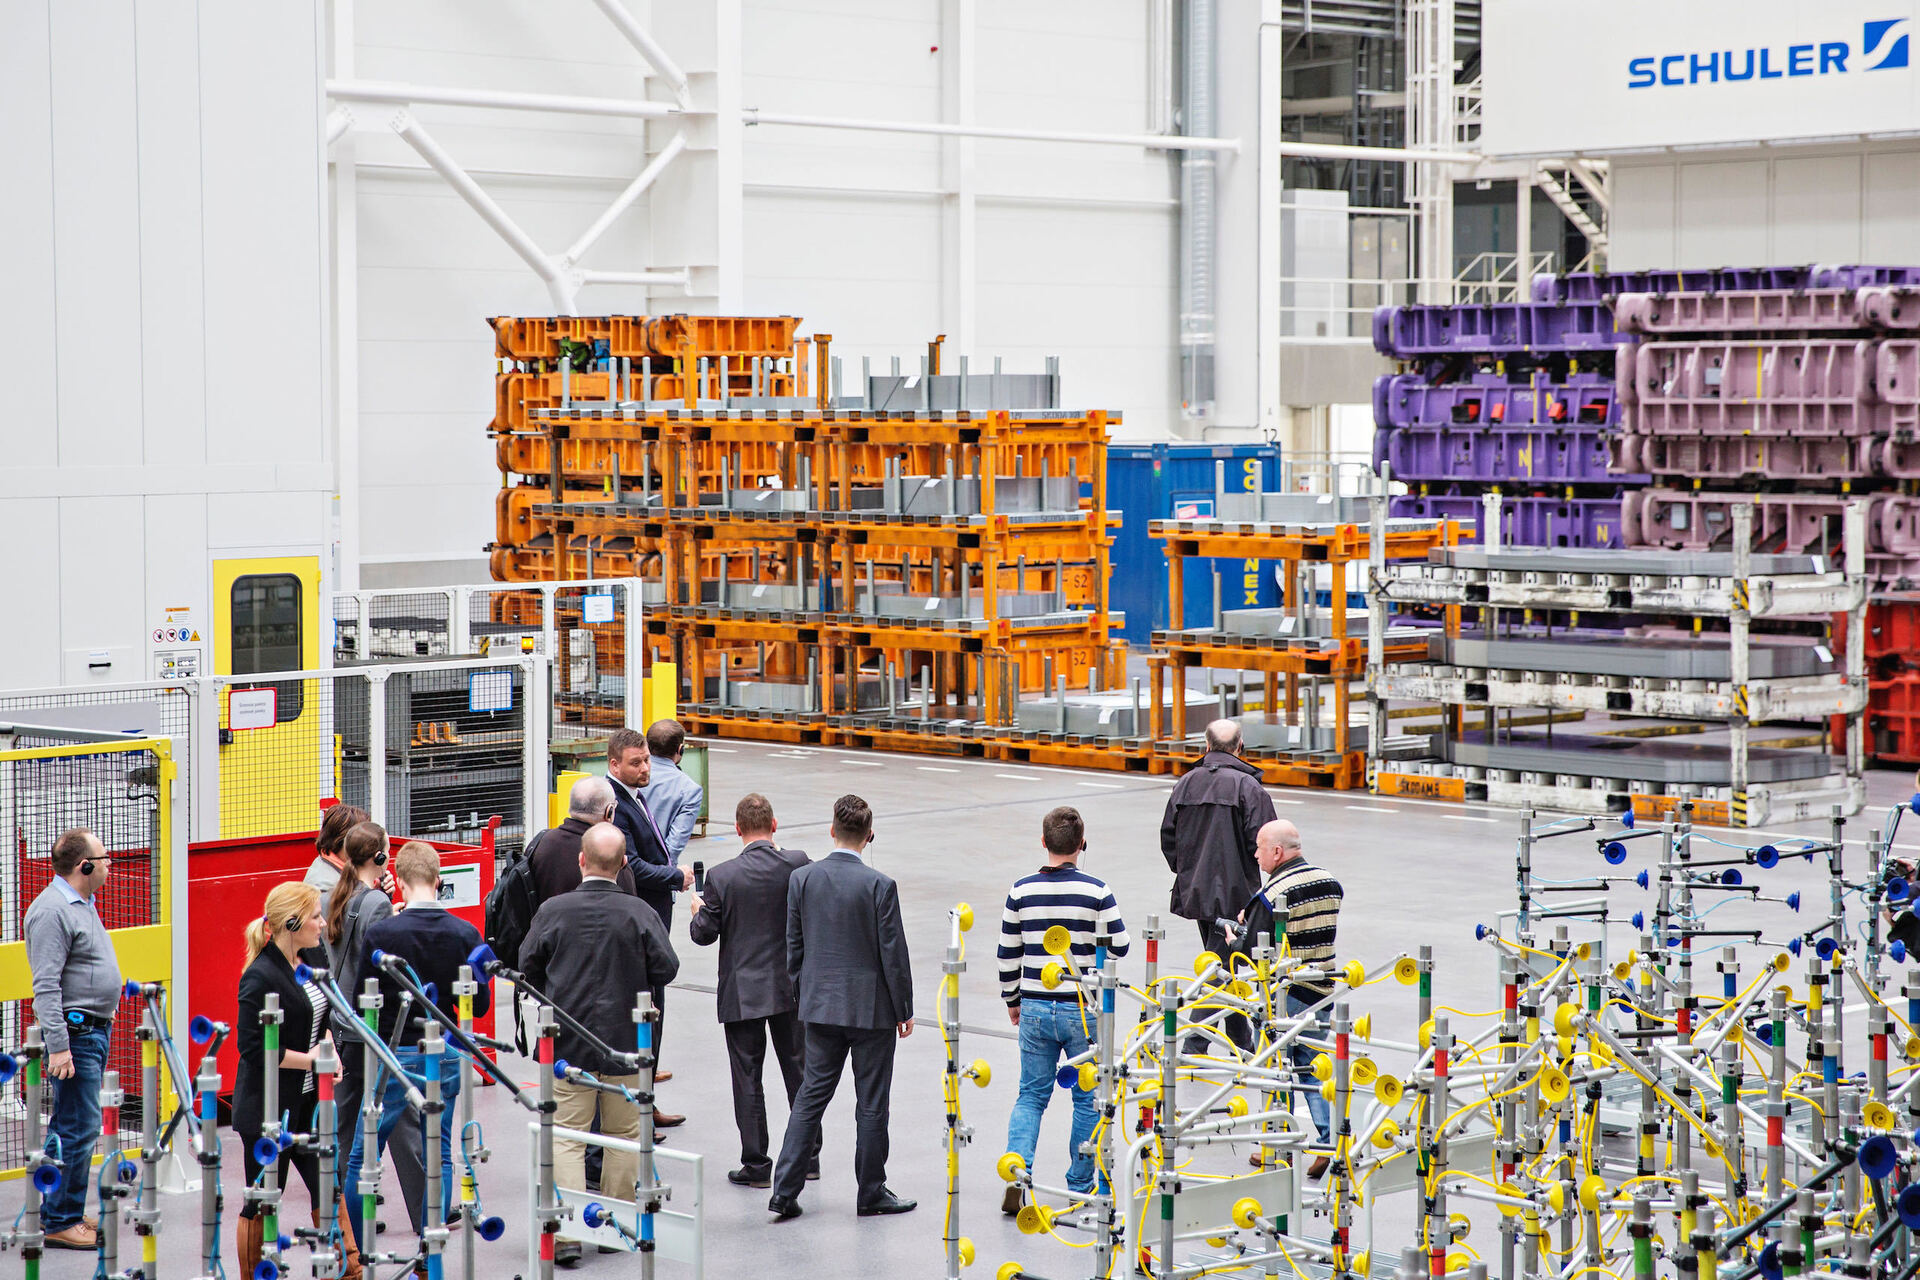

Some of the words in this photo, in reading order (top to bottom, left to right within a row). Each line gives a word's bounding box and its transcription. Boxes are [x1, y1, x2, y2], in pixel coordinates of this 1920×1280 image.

[1628, 42, 1850, 89] SCHULER
[1596, 524, 1608, 542] N
[1074, 574, 1088, 588] S2
